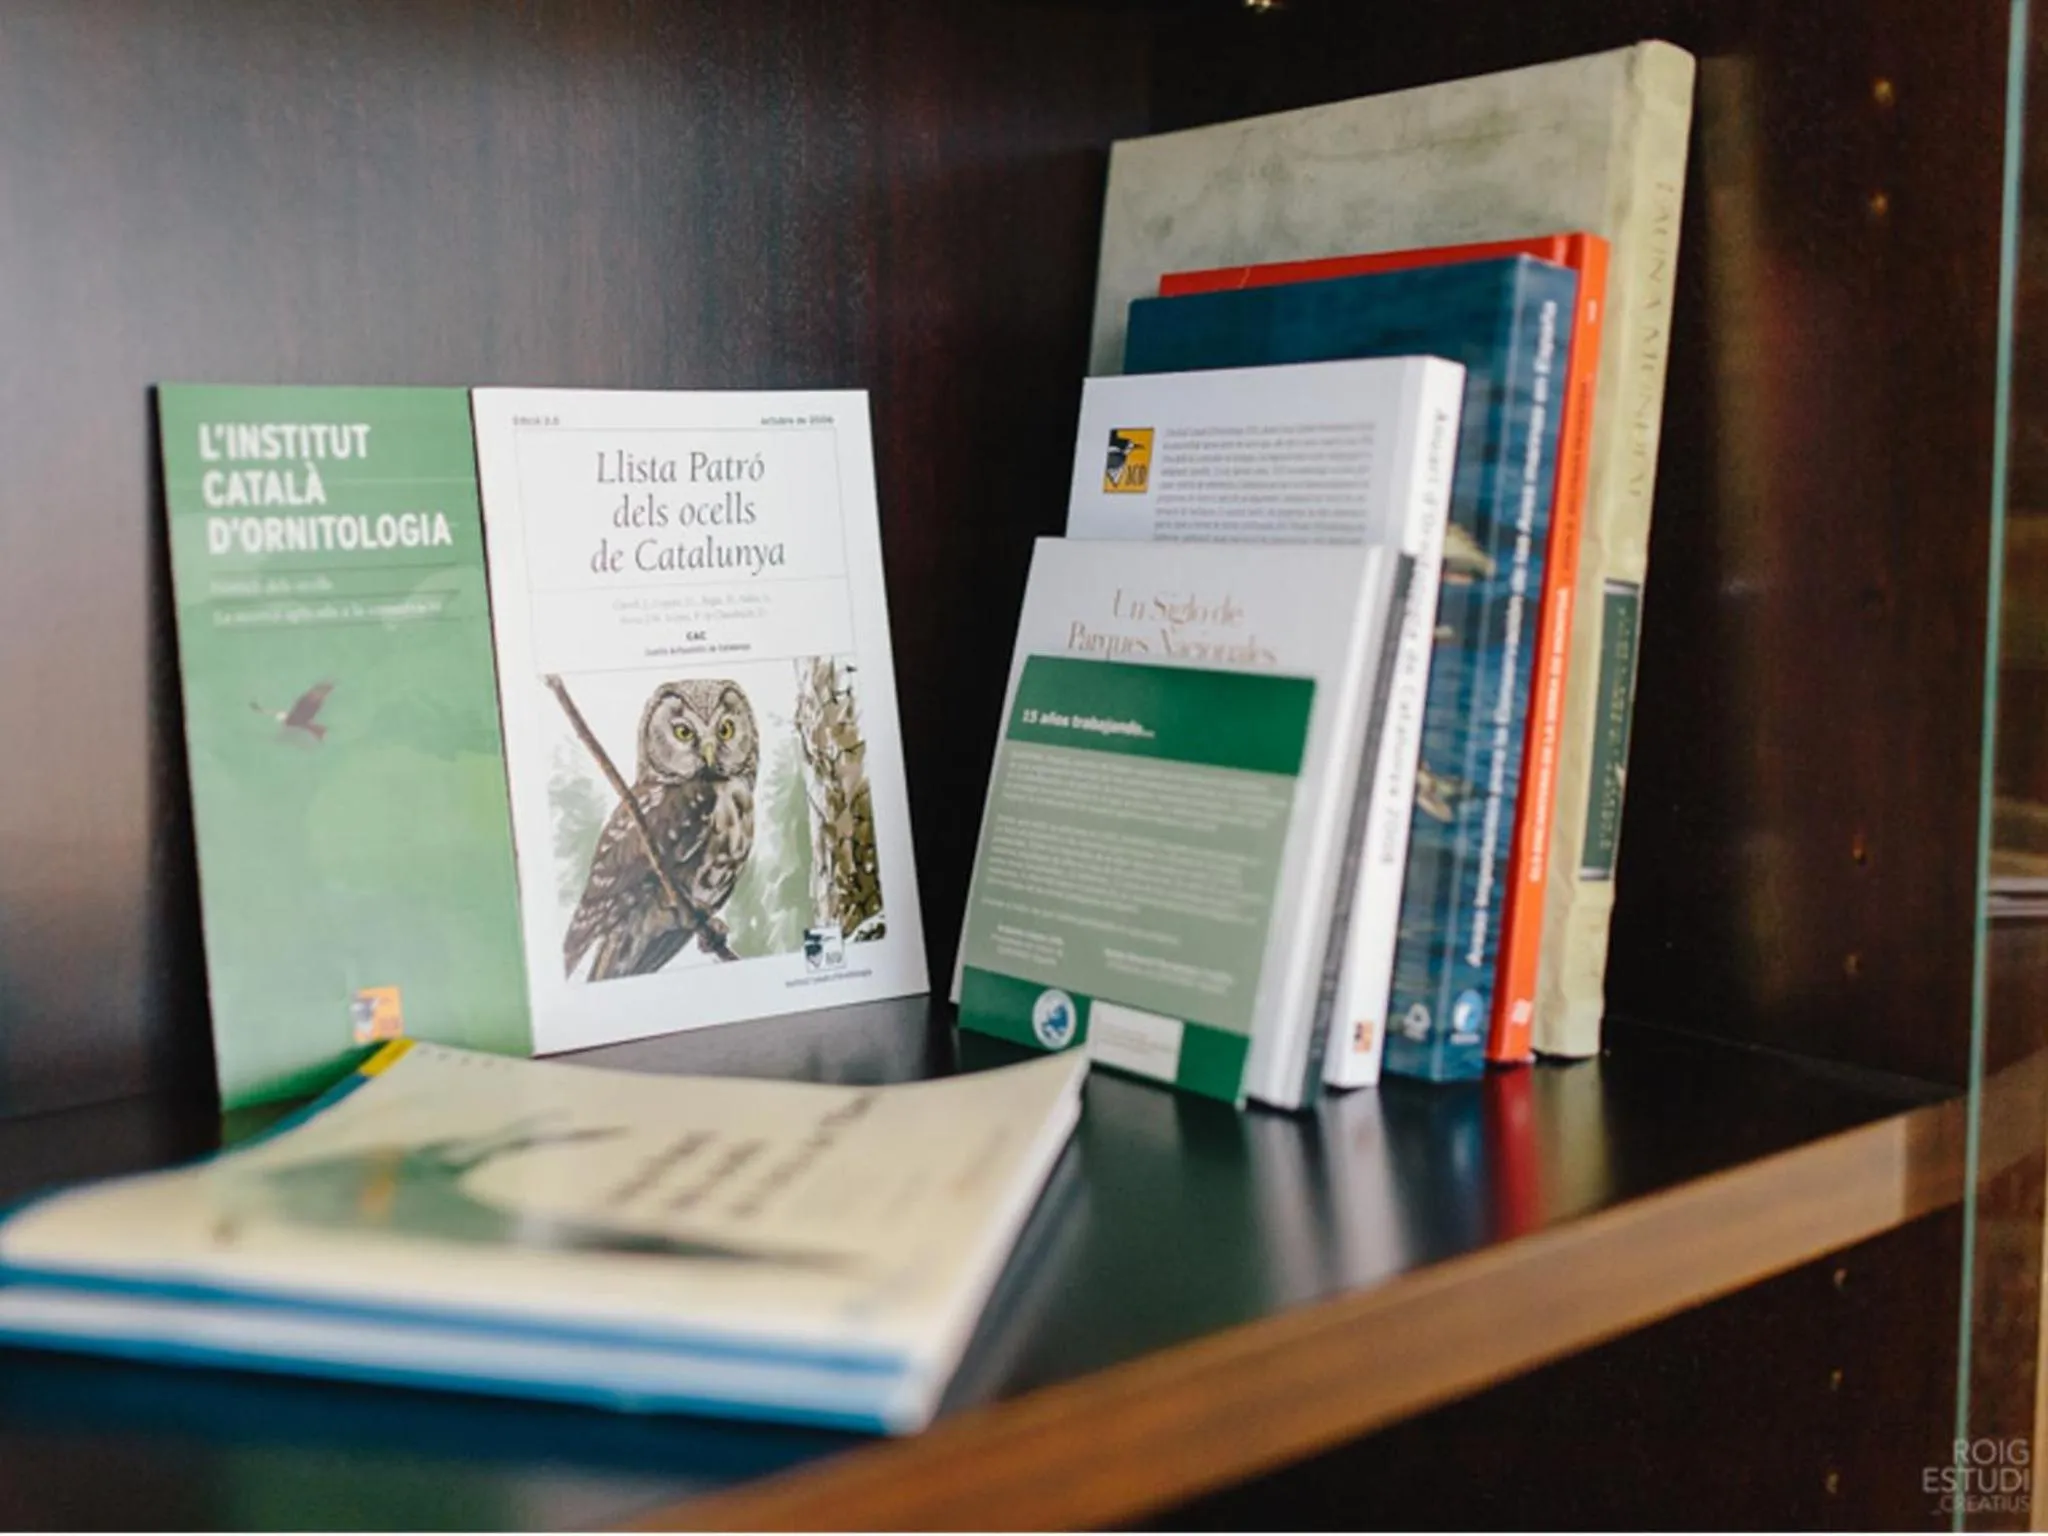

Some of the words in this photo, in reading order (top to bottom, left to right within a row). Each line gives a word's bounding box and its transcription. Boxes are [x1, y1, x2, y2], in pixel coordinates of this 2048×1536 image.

[199, 422, 371, 460] L'INSTITUT
[203, 460, 327, 508] CATALÀ
[597, 449, 678, 486] Llista
[689, 450, 766, 484] Patró
[613, 494, 670, 528] dels
[679, 490, 757, 527] ocells
[208, 512, 453, 556] D'ORNITOLOGIA
[591, 538, 624, 574] de
[635, 534, 786, 578] Catalunya
[1068, 619, 1149, 661] Parques
